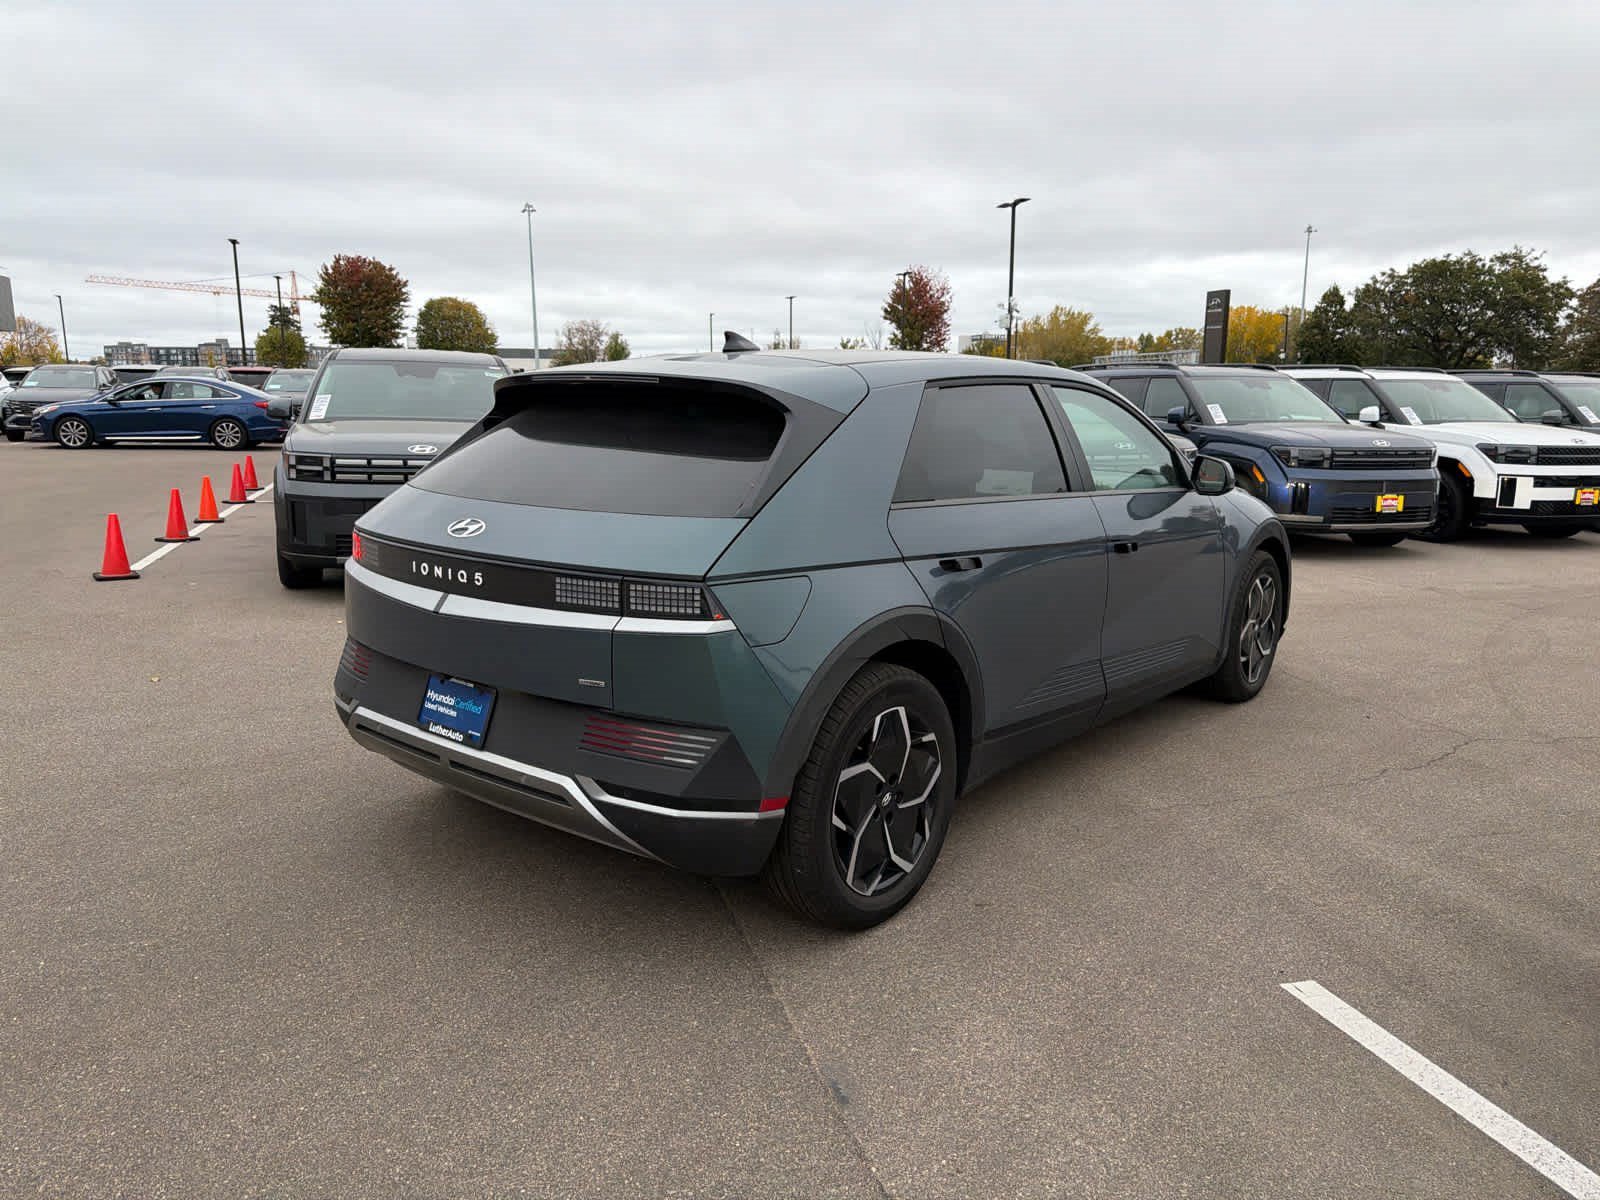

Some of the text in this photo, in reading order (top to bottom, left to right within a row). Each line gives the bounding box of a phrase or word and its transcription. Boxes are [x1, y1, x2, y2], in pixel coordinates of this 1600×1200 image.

[412, 560, 483, 586] IONIQ 5
[427, 689, 456, 706] Hyundai
